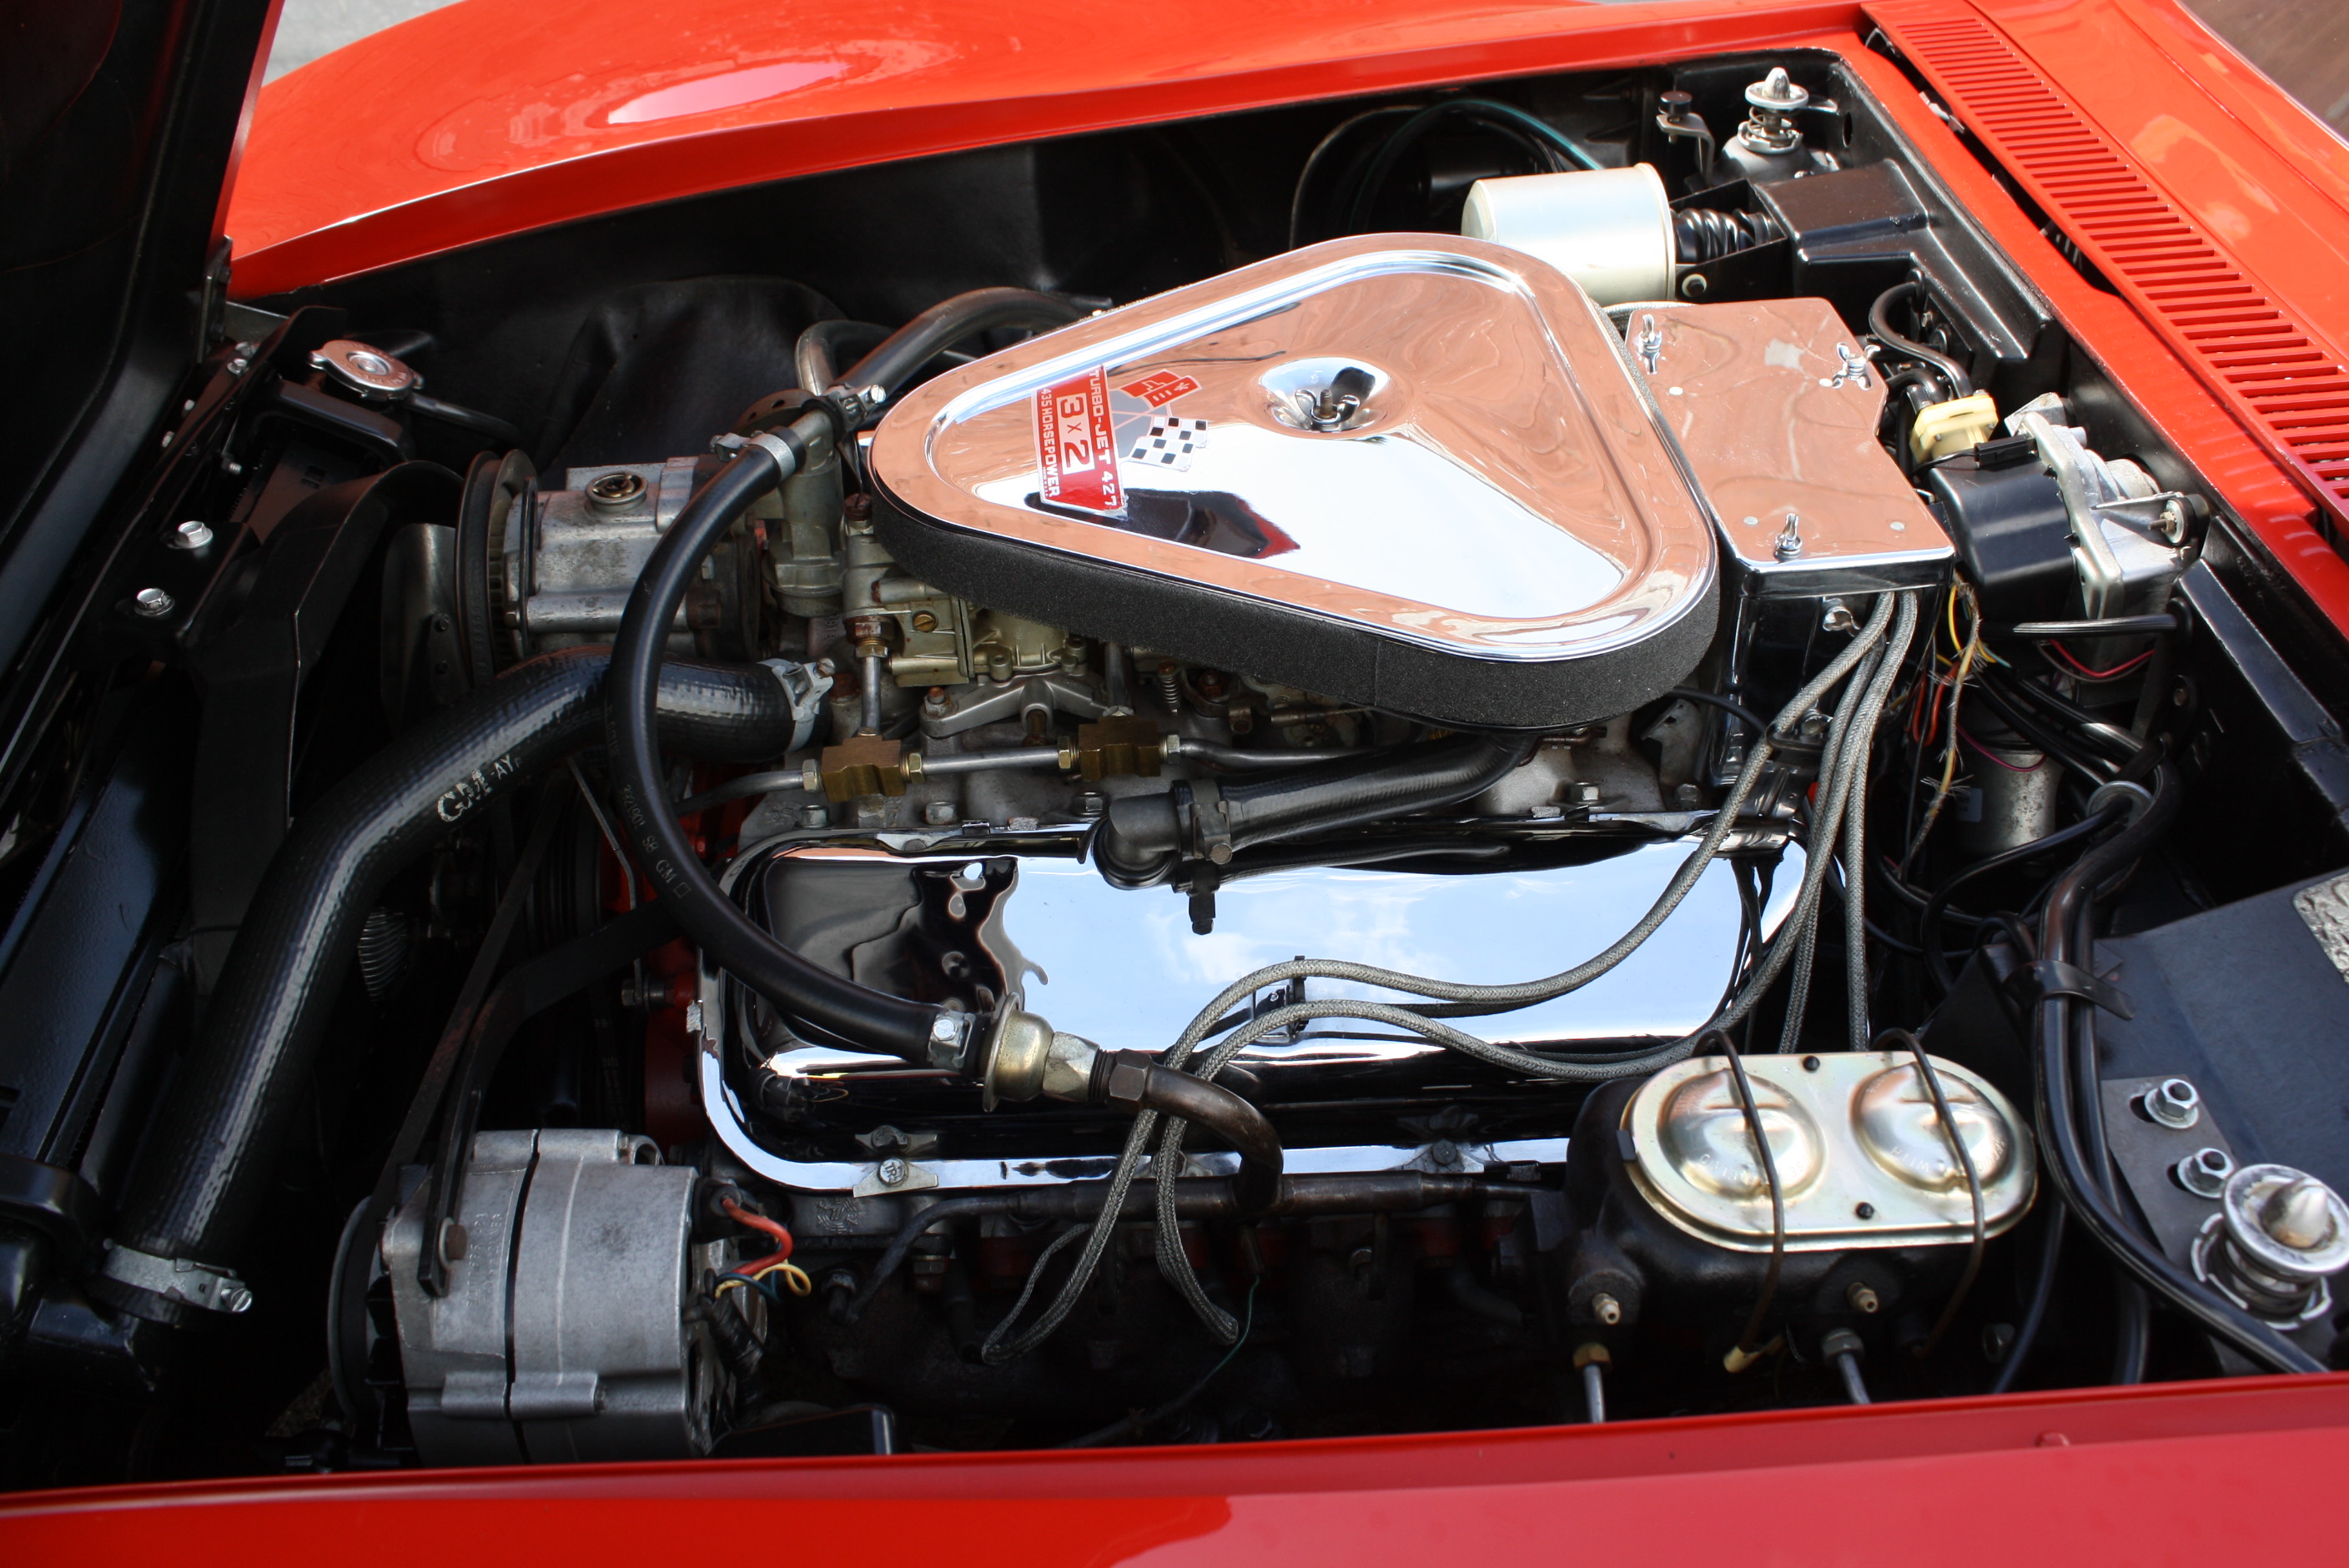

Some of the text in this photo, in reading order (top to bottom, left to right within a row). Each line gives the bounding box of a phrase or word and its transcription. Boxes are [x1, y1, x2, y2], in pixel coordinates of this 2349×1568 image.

[1040, 388, 1053, 407] 435
[1060, 396, 1084, 419] 3
[1089, 369, 1117, 506] TURBO-JET 427
[1041, 408, 1061, 498] HORSEPOWER
[1064, 440, 1090, 468] 2
[656, 859, 678, 884] GM
